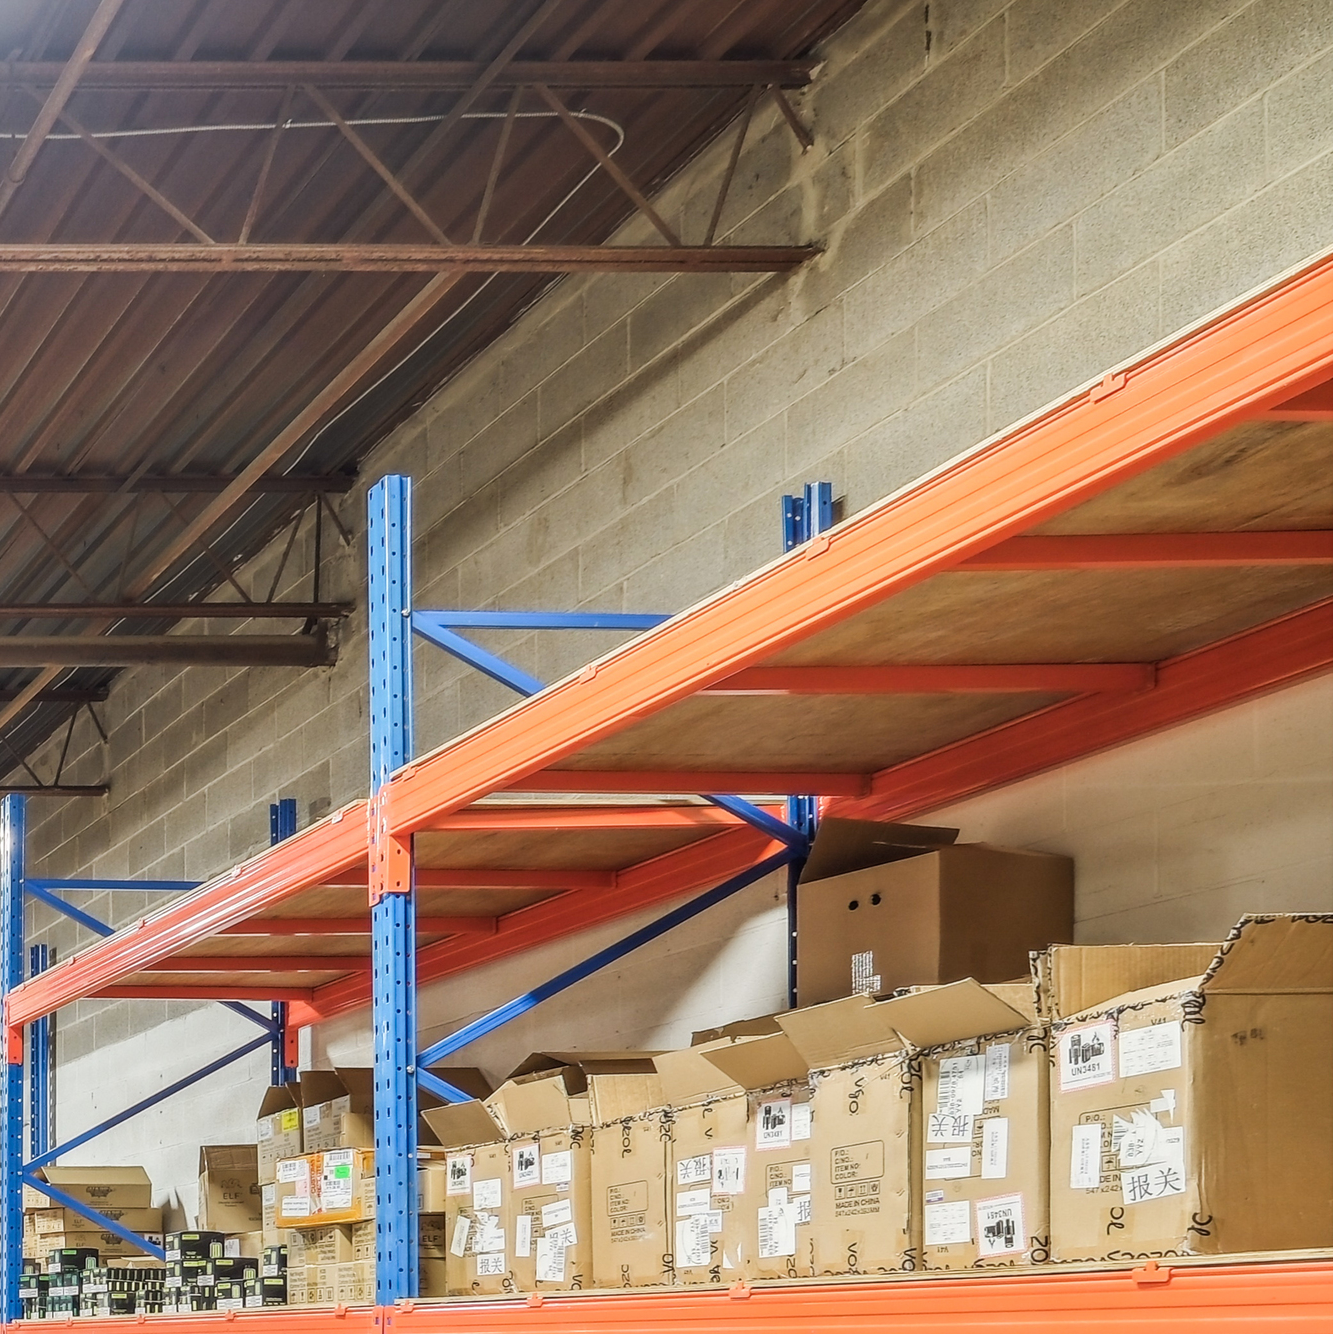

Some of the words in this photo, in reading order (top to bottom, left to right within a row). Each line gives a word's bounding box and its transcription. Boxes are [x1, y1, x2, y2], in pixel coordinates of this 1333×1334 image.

[1085, 1114, 1106, 1122] P/O.:
[835, 1164, 849, 1172] ITEM
[835, 1171, 858, 1180] COLOR:
[1113, 1175, 1122, 1183] IN
[1127, 1167, 1182, 1201] 报关
[835, 1201, 852, 1209] MADE
[861, 1198, 880, 1206] CHINA
[422, 1235, 439, 1243] ELF
[480, 1257, 503, 1274] 报关
